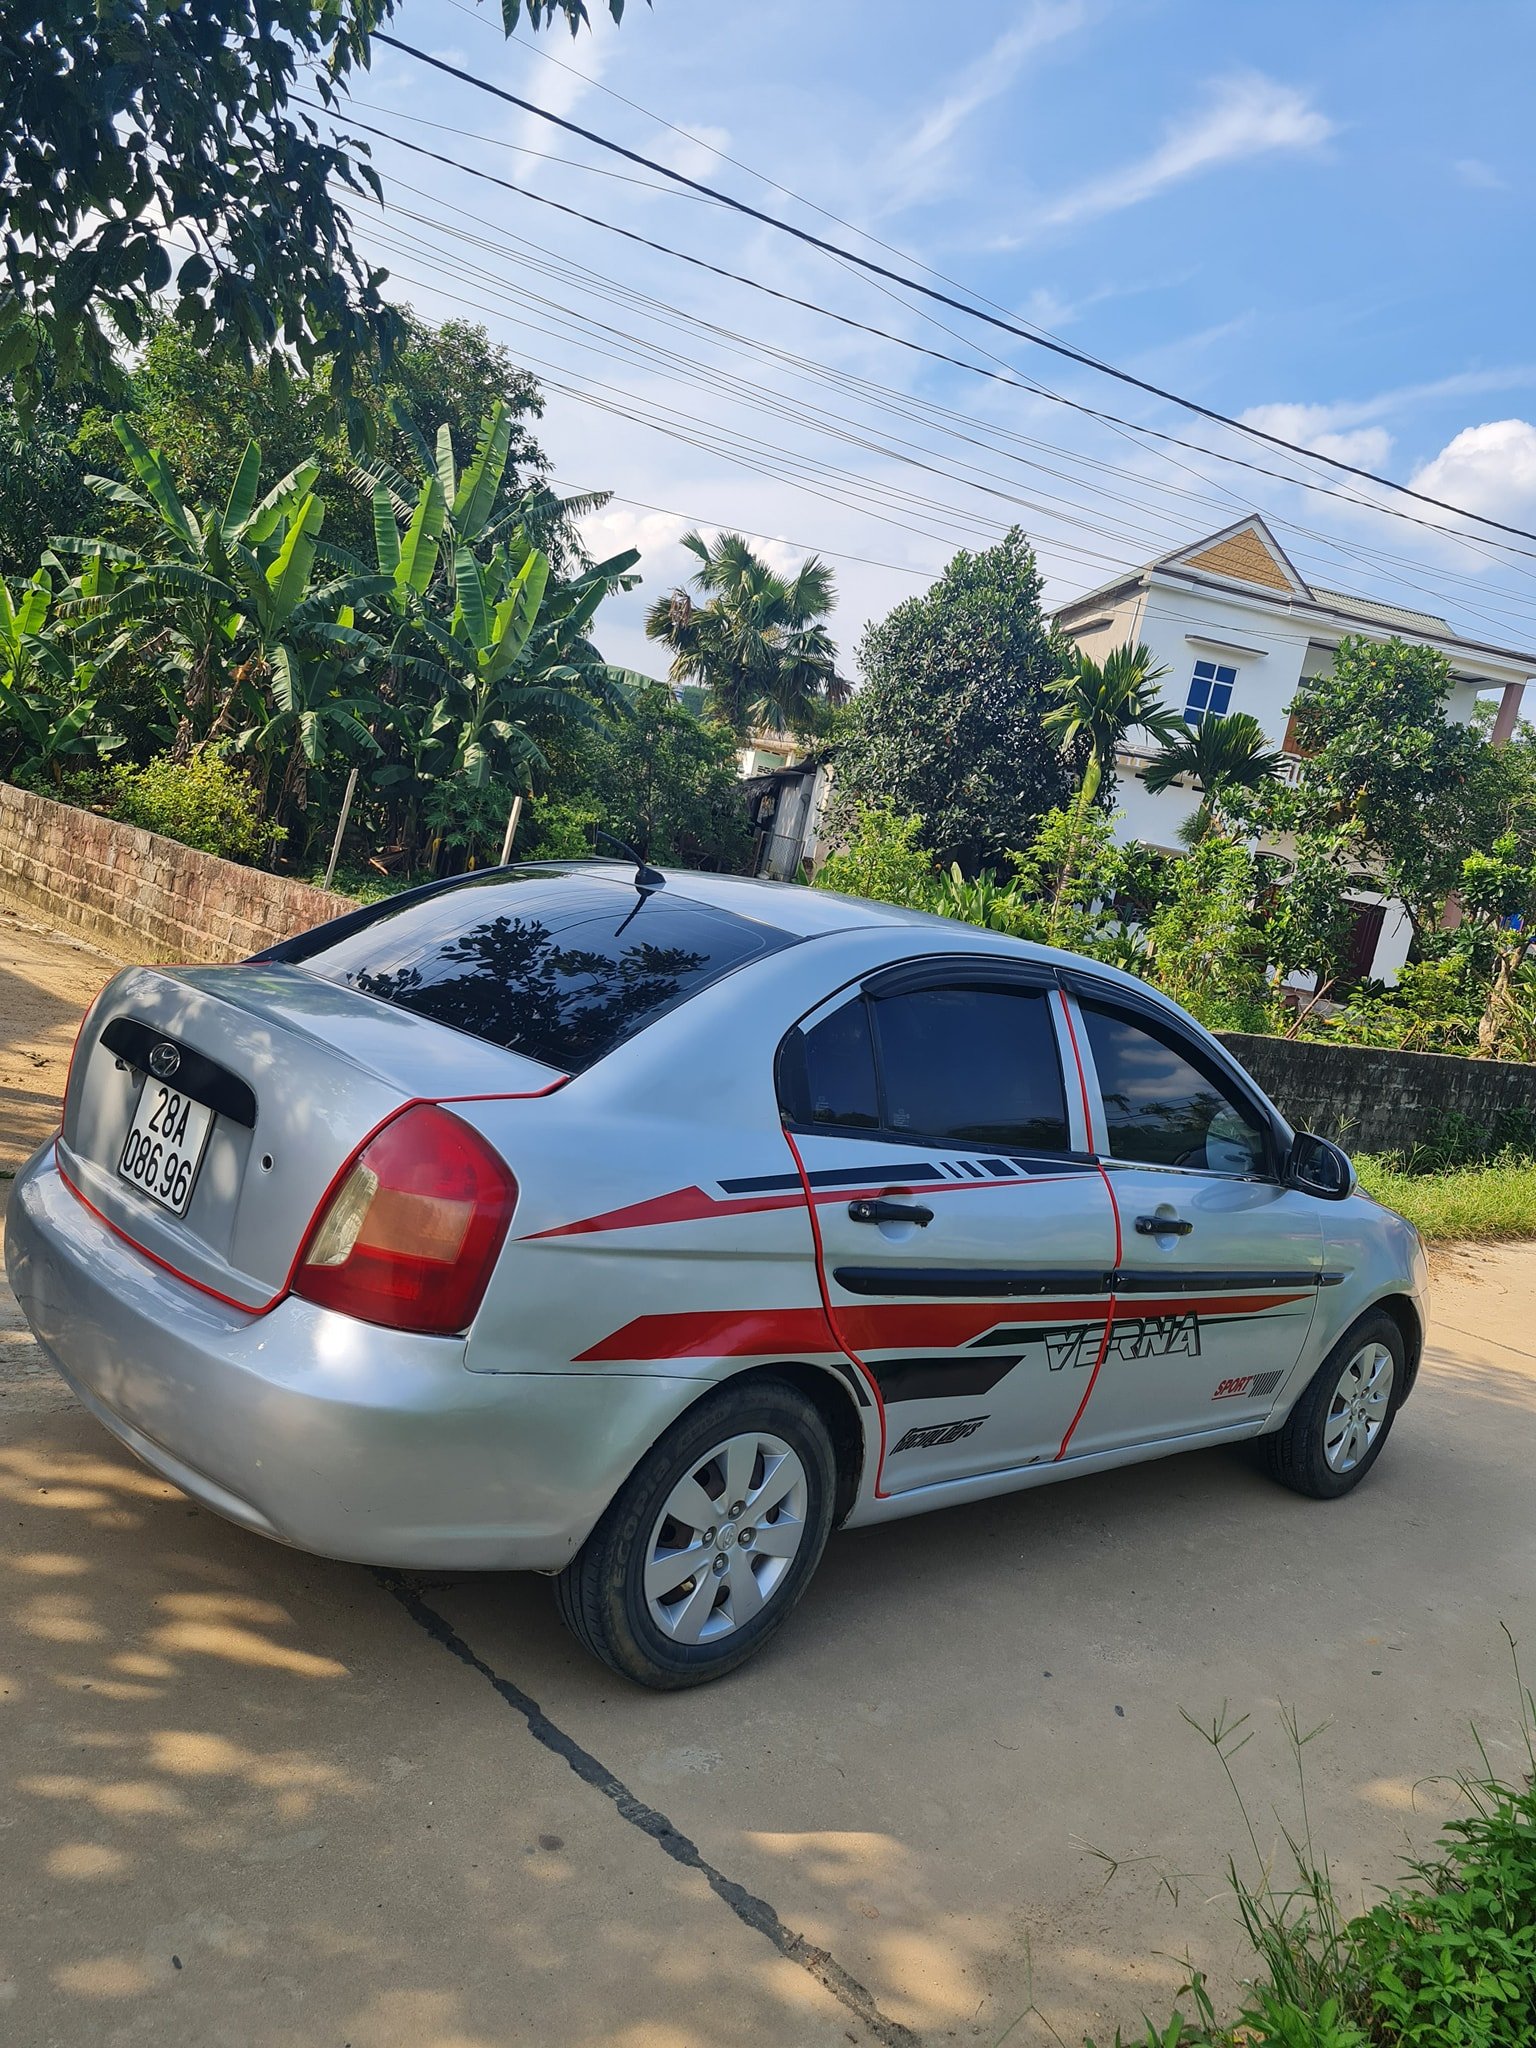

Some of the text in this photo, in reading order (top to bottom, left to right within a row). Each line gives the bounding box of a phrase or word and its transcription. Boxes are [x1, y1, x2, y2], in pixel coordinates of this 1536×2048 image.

[148, 1087, 192, 1147] 28A
[123, 1128, 192, 1206] 086.96
[1044, 1311, 1202, 1371] VERNA
[1213, 1374, 1254, 1397] SPORT
